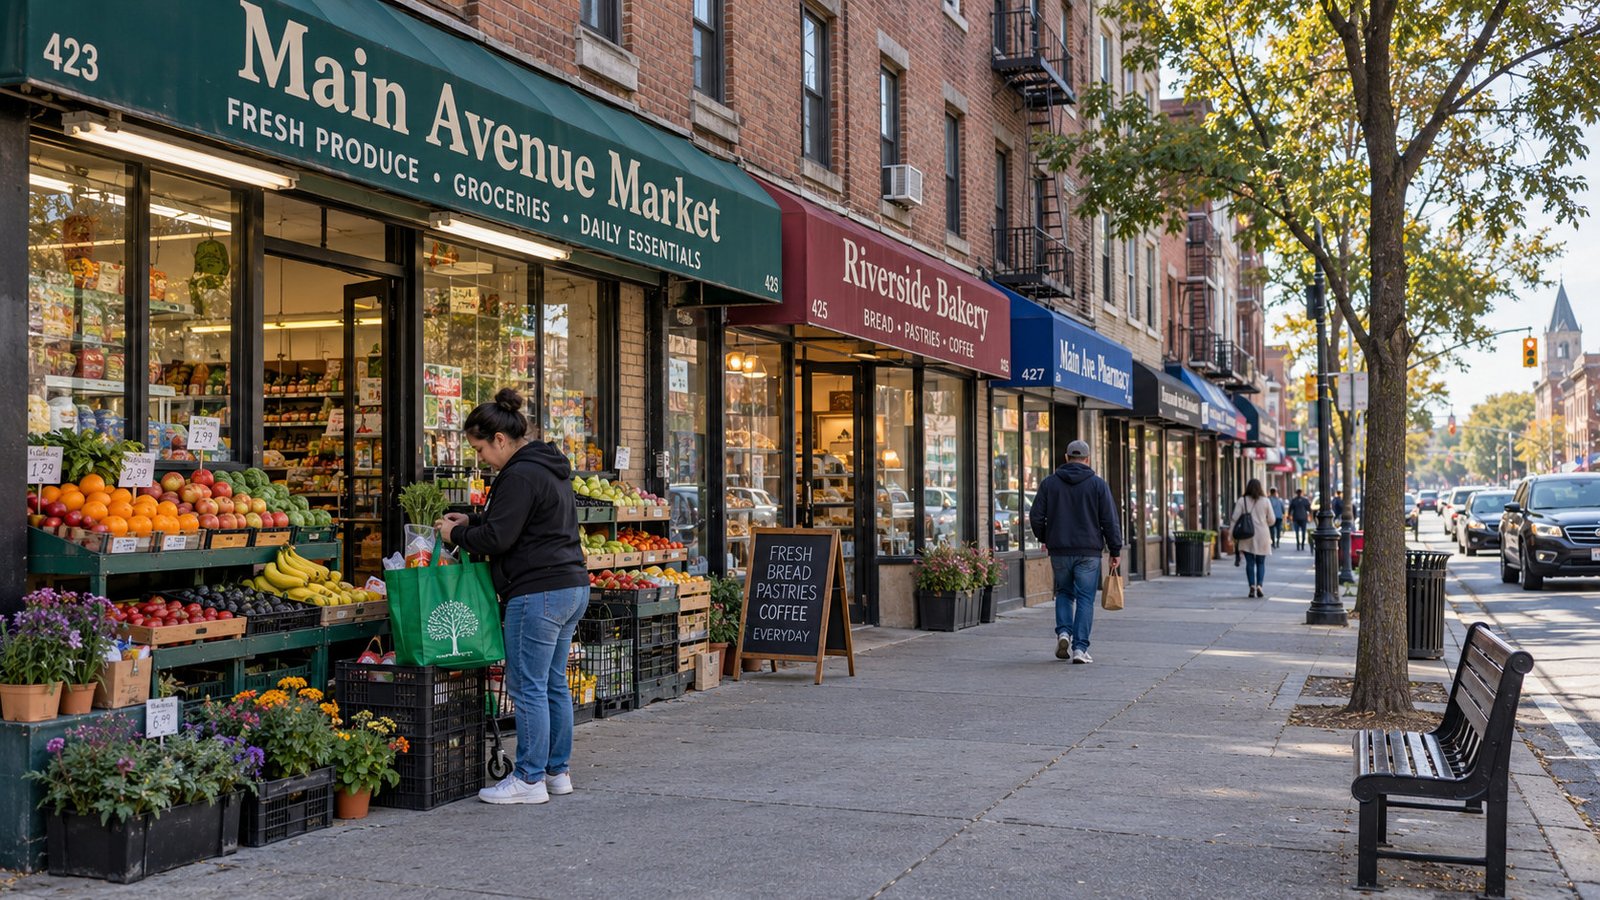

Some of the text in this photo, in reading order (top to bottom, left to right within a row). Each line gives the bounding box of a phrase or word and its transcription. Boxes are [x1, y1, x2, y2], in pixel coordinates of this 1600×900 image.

[44, 33, 99, 82] 423
[238, 1, 721, 243] Main Avenue Market
[227, 97, 702, 270] FRESH PRODUCE GROCERIES DAILY ESSENTIALS
[842, 238, 989, 342] Riverside Bakery
[812, 299, 828, 319] 425
[864, 308, 975, 359] BREAD PASTRIES COFFEE
[1022, 368, 1045, 380] 427
[1060, 339, 1080, 375] Main
[1081, 348, 1097, 380] Ave.
[1097, 354, 1130, 400] Pharmacy
[194, 430, 213, 444] 2.99
[30, 462, 54, 477] 1.29
[126, 467, 148, 481] 2.99
[769, 545, 813, 562] FRESH
[767, 564, 812, 581] BREAD
[756, 583, 817, 601] PASTRIES
[759, 603, 809, 622] COFFEE
[753, 627, 811, 642] EVERYDAY
